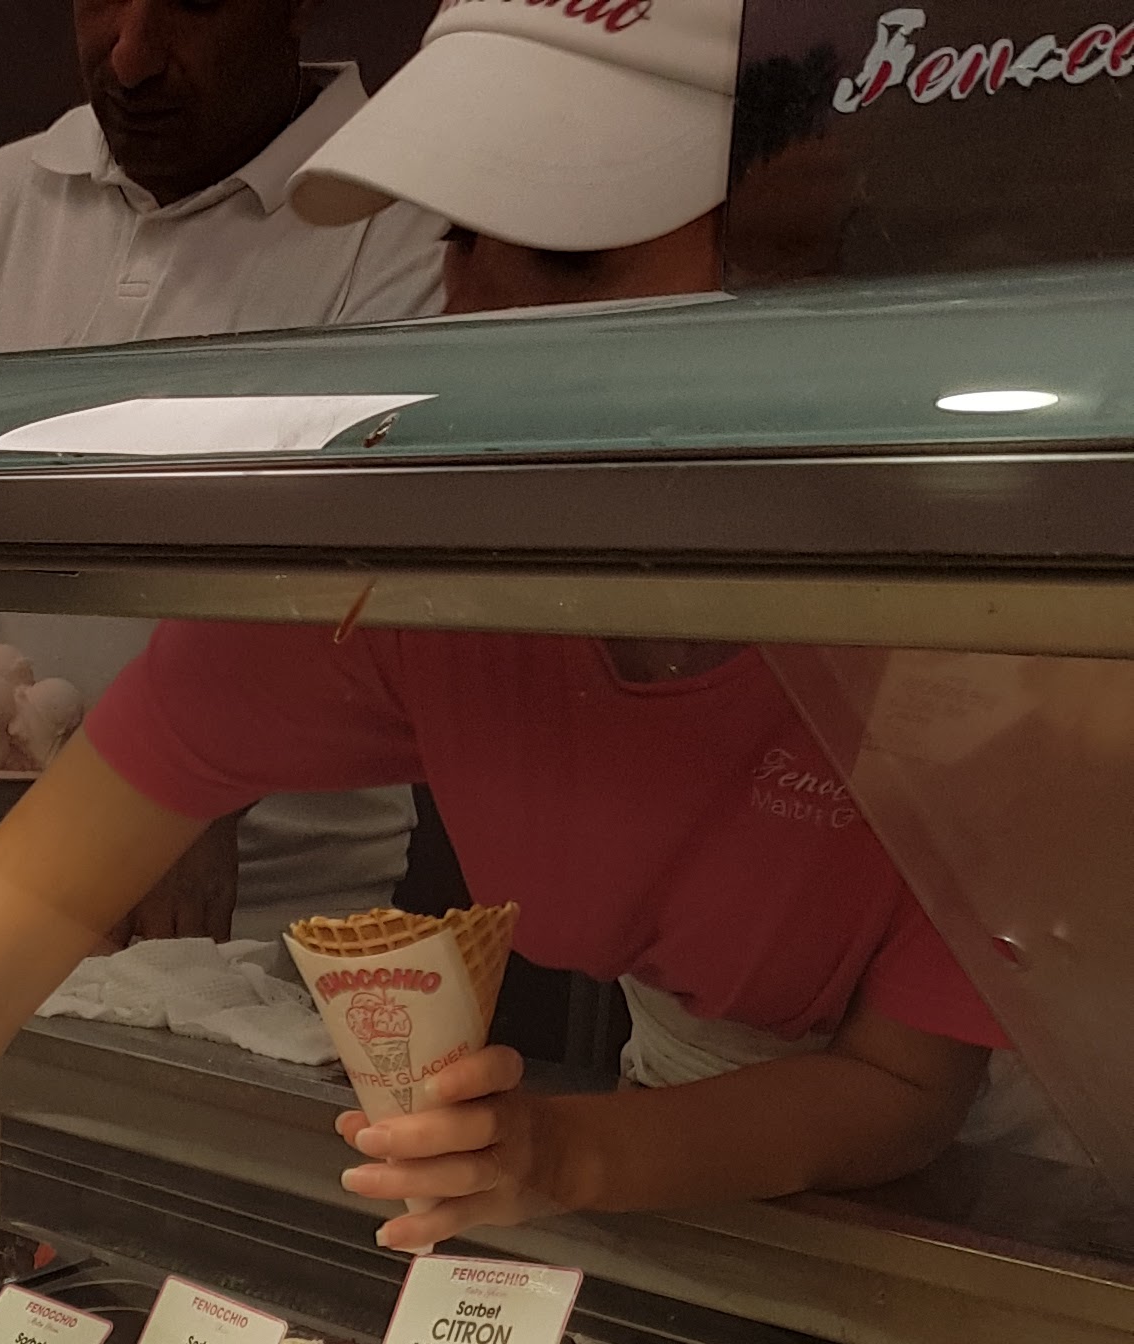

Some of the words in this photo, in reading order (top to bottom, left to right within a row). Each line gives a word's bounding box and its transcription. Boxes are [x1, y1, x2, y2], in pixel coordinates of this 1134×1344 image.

[451, 1267, 530, 1287] FENOCCHIO
[25, 1301, 79, 1328] FENOCCHIO
[192, 1297, 249, 1329] FENOCCHIO
[456, 1300, 502, 1320] Sorbet
